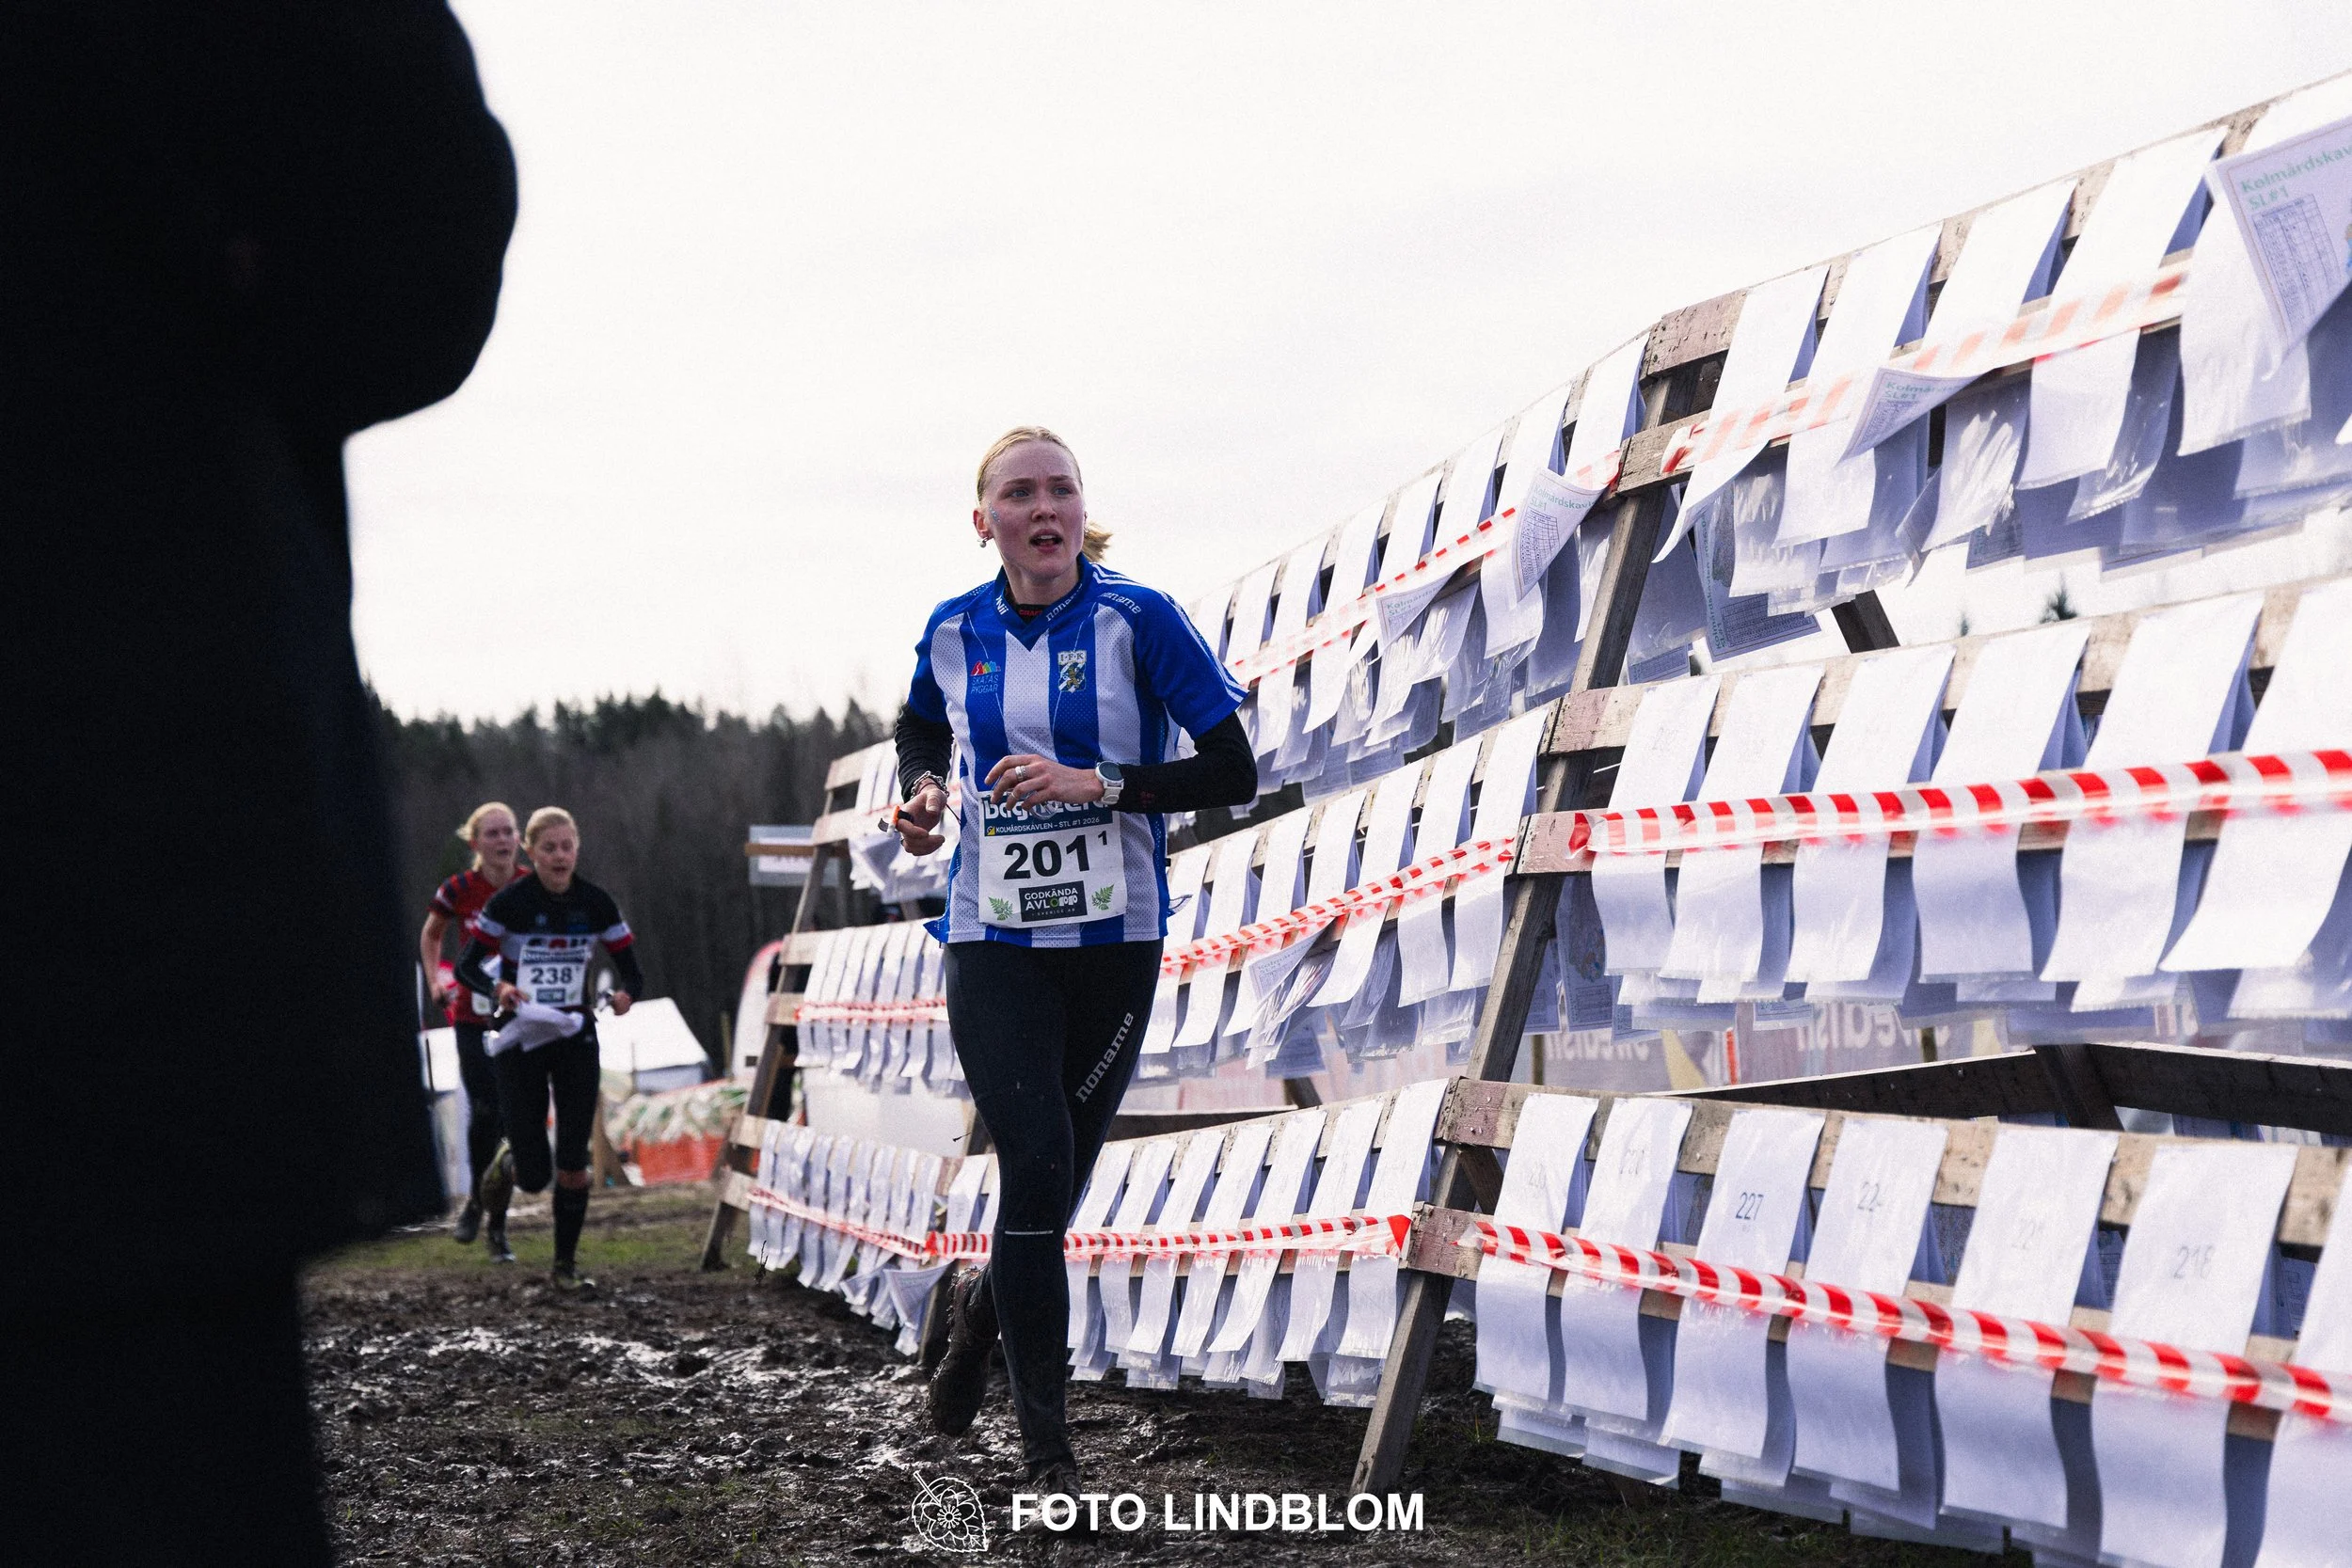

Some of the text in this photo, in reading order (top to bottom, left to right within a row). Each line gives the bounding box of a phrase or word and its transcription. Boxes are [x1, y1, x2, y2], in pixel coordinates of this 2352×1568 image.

[1082, 816, 1100, 824] 2026
[1097, 830, 1108, 846] 1
[1003, 834, 1089, 880] 201
[1025, 887, 1078, 900] GODKÄNDA
[530, 967, 573, 985] 238
[1075, 1012, 1135, 1103] noname
[1735, 1192, 1764, 1221] 227
